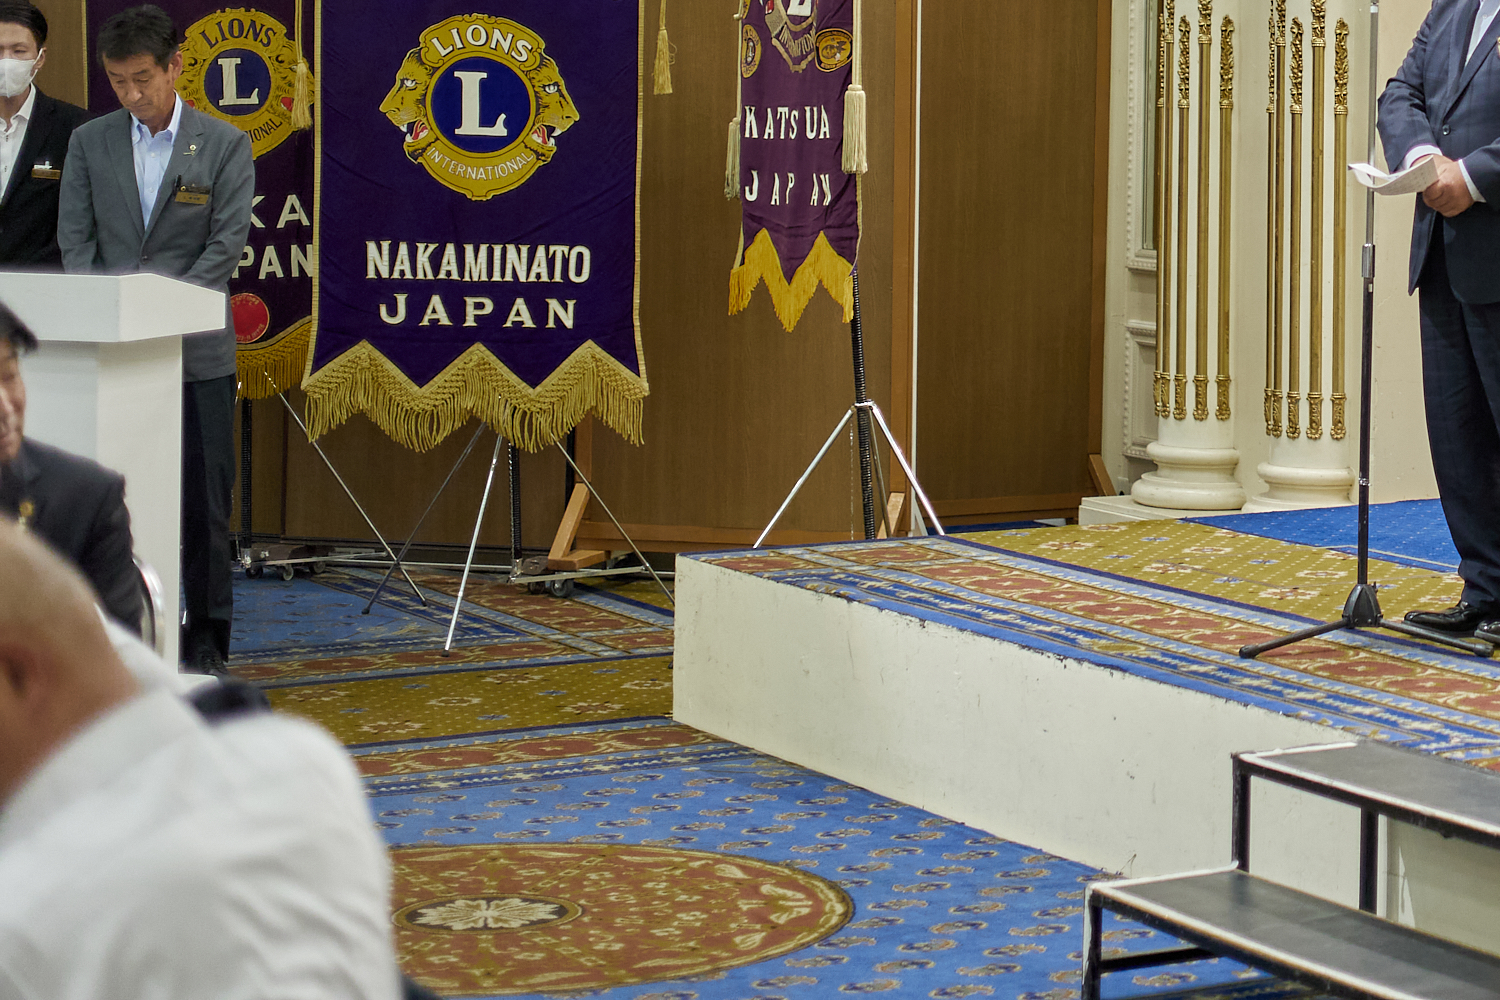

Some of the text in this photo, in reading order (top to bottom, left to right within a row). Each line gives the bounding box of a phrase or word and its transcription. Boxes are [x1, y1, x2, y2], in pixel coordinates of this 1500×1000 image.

[199, 17, 277, 50] LIONS
[430, 23, 534, 63] LIONS
[217, 57, 260, 106] L
[453, 70, 508, 137] L
[426, 146, 535, 182] INTERNATIONAL
[365, 240, 592, 284] NAKAMINATO
[378, 293, 578, 330] JAPAN
